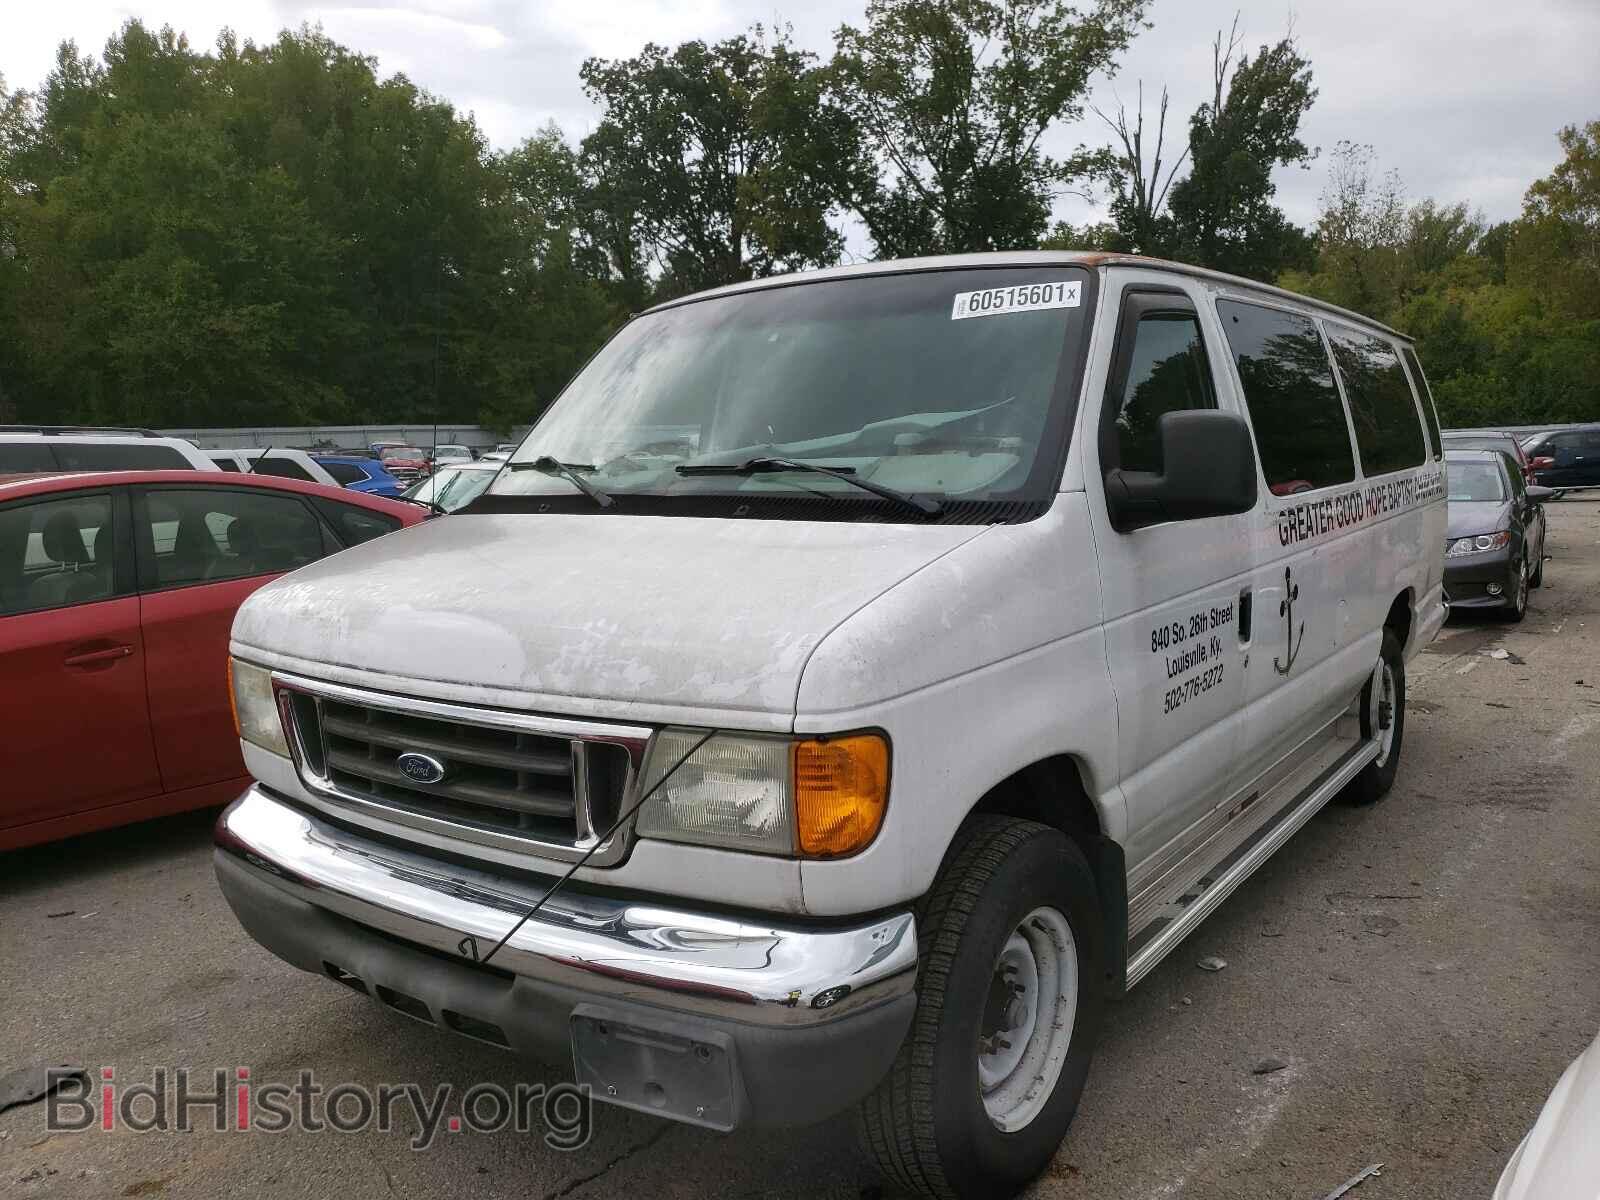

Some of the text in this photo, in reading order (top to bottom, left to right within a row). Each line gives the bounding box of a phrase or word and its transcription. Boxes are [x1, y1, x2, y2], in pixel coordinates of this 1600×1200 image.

[969, 284, 1064, 312] 60515601
[1278, 500, 1333, 546] GREATER
[1336, 491, 1364, 528] GOOD
[1365, 484, 1387, 518] HOPE
[1389, 478, 1413, 508] BAPTIST
[1151, 602, 1233, 653] 840 So. 26th Street
[1166, 636, 1222, 678] Louisville, Ky.
[1164, 663, 1224, 714] 502-776-5272
